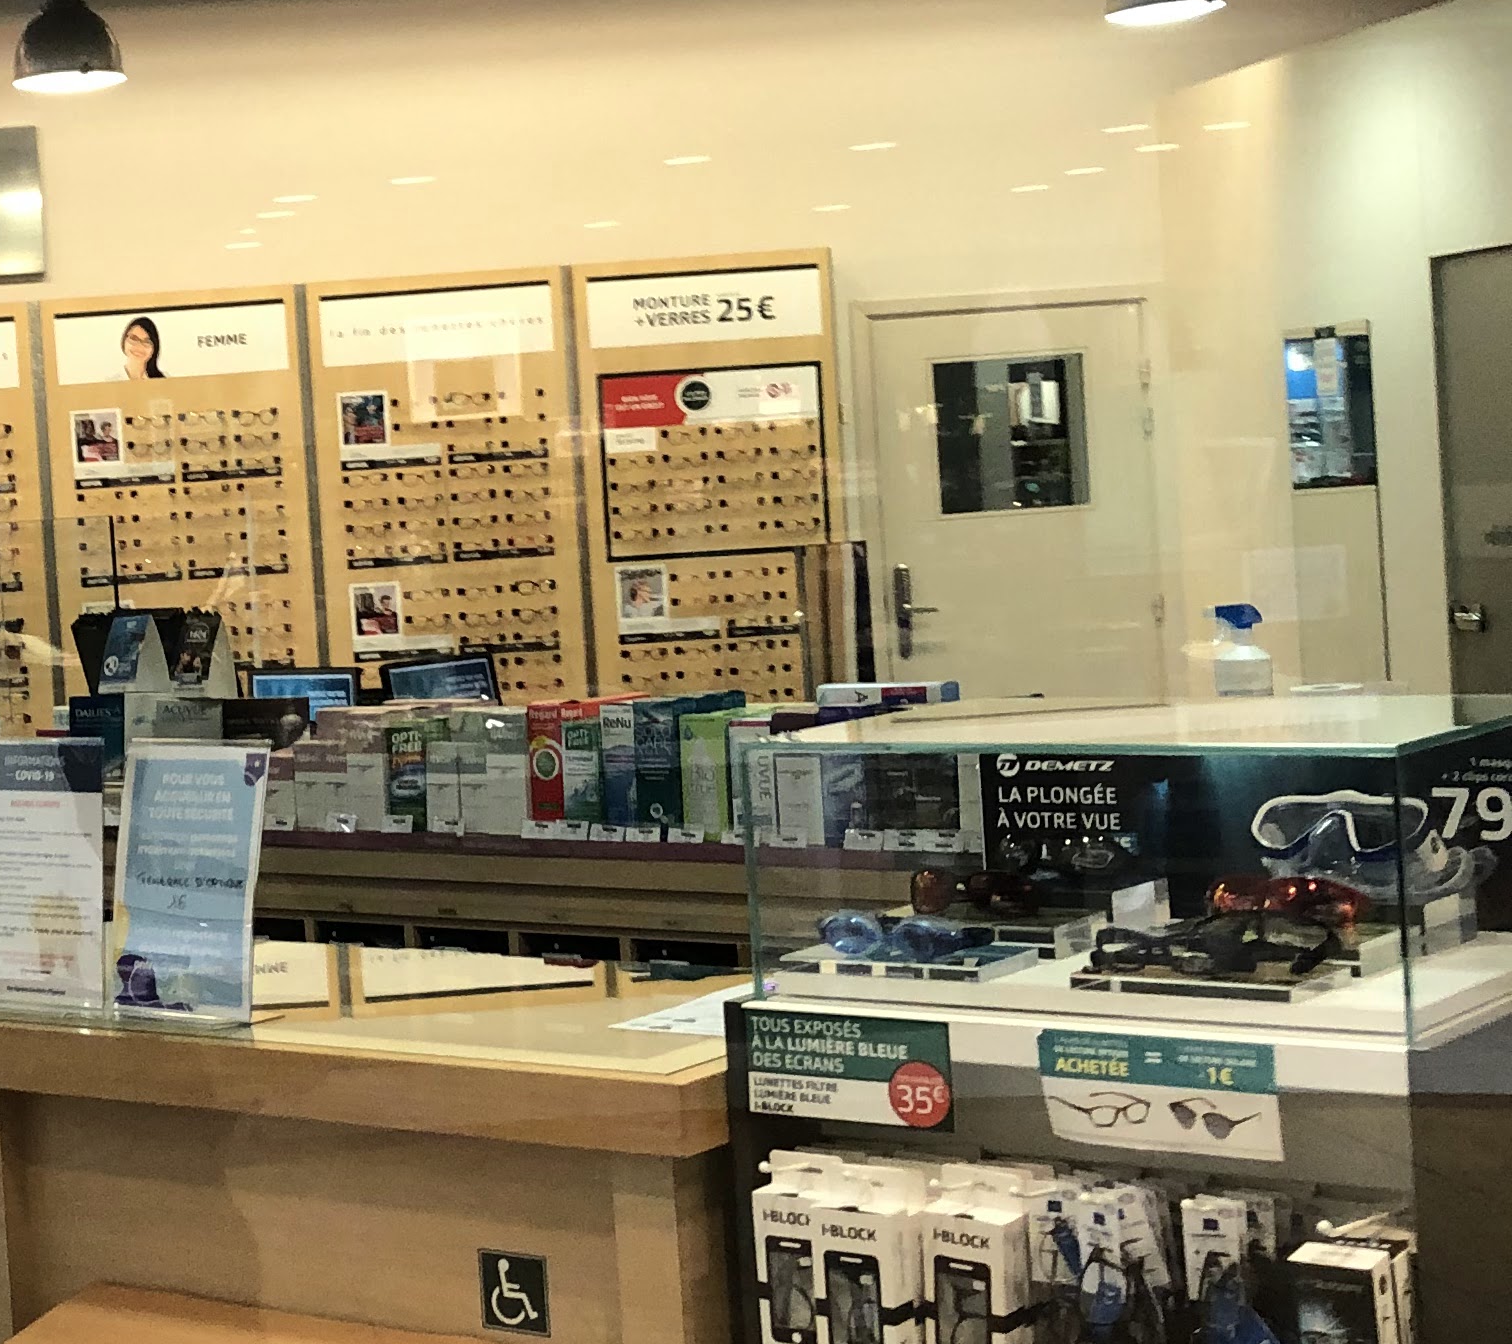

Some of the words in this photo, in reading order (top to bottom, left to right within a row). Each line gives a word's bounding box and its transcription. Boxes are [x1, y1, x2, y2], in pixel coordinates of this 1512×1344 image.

[632, 293, 711, 311] MONTURE
[716, 295, 776, 323] 25€
[197, 333, 248, 348] FEMME
[603, 716, 631, 729] ReNu
[392, 742, 422, 754] FREE
[15, 769, 55, 782] COVID-19
[1024, 760, 1115, 772] DEMETZ
[998, 786, 1022, 803] LA
[1027, 782, 1117, 805] PLONGÉE
[997, 807, 1010, 828] À
[1013, 811, 1077, 829] VOTRE
[1080, 812, 1122, 830] VUE
[751, 1016, 790, 1033] TOUS
[794, 1019, 862, 1039] EXPOSÉS
[765, 1035, 785, 1050] LA
[788, 1036, 855, 1056] LUMIÈRE
[858, 1042, 908, 1060] BLEUE
[753, 1051, 782, 1068] DES
[1054, 1054, 1129, 1077] ACHETÉE
[1207, 1066, 1235, 1086] 1€
[800, 1092, 832, 1105] BLEUE
[896, 1084, 946, 1115] 35€
[821, 1223, 878, 1242] I-BLOCK
[933, 1227, 991, 1250] I-BLOCK
